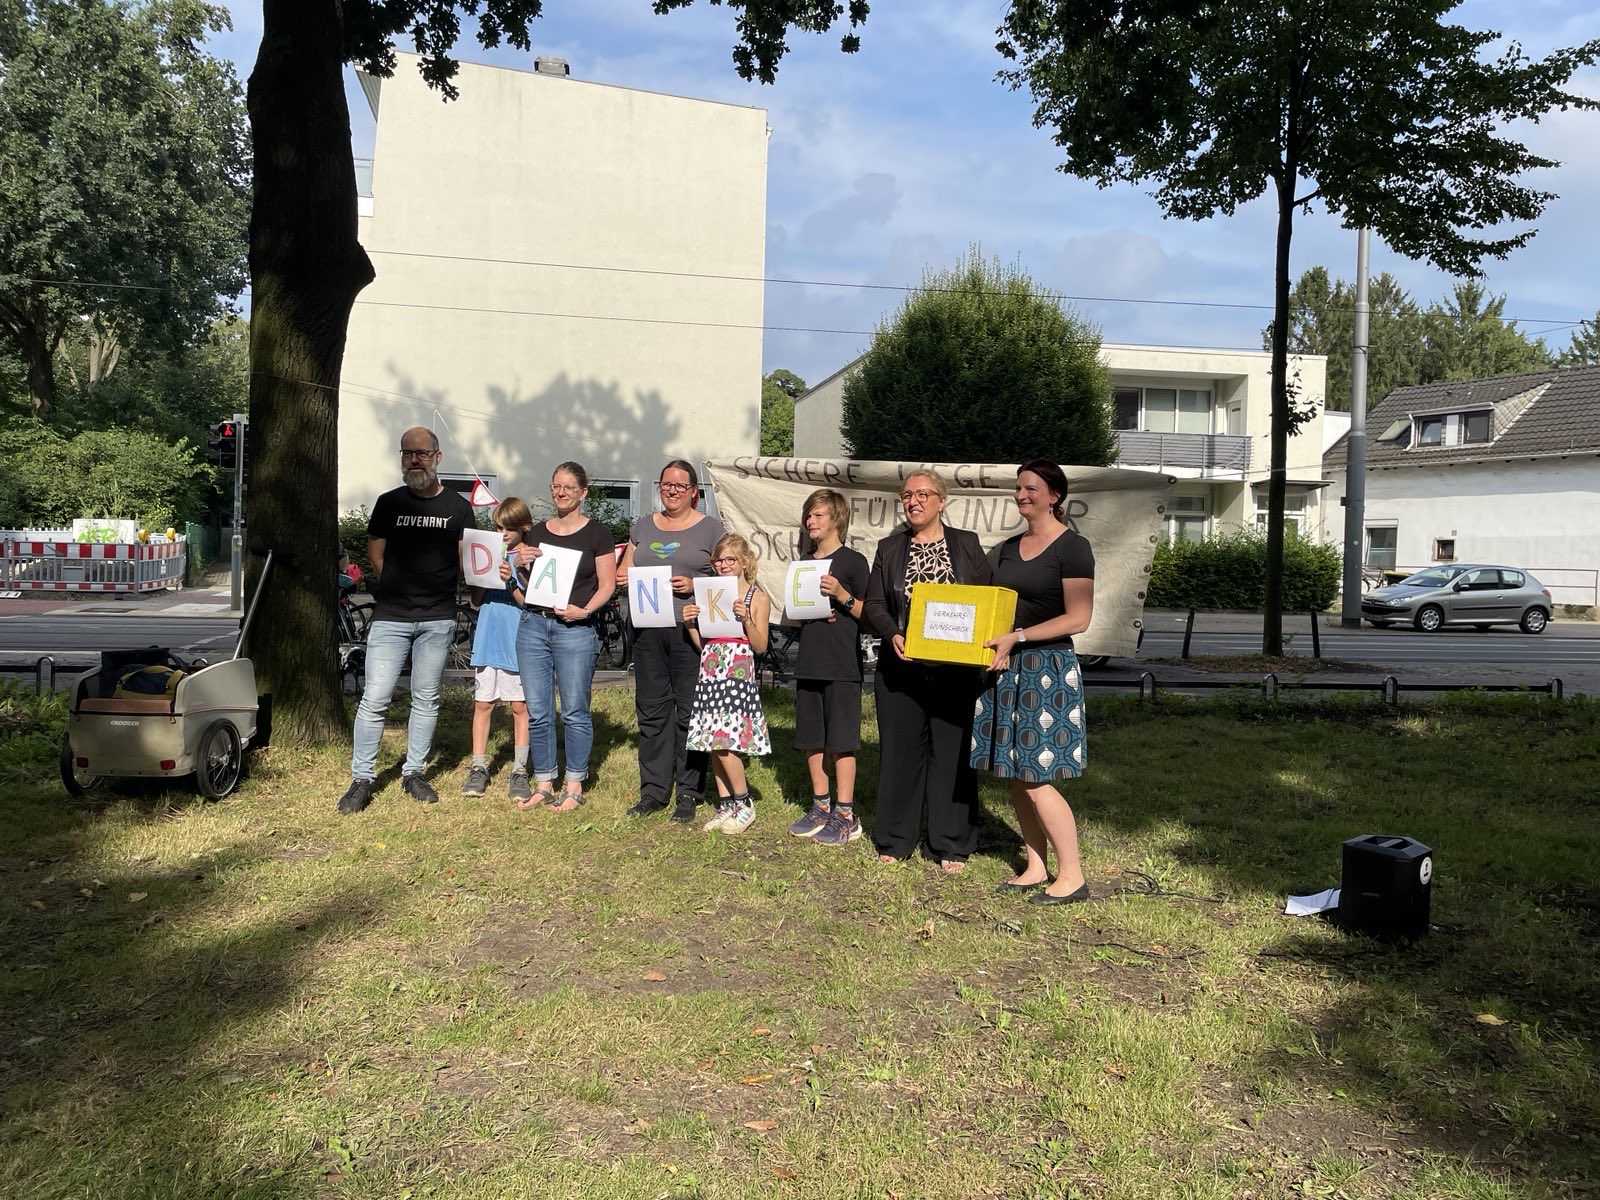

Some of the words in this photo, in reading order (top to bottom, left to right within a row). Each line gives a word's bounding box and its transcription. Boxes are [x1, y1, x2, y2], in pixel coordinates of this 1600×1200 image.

[733, 456, 866, 485] SICHERE
[897, 463, 1000, 489] GE
[394, 515, 453, 529] COVENANT
[943, 498, 1089, 534] KINDR
[470, 542, 493, 576] D
[534, 558, 558, 594] A
[637, 577, 660, 615] N
[793, 566, 816, 607] E
[706, 588, 730, 623] K
[929, 623, 969, 633] WUNSCHBOX
